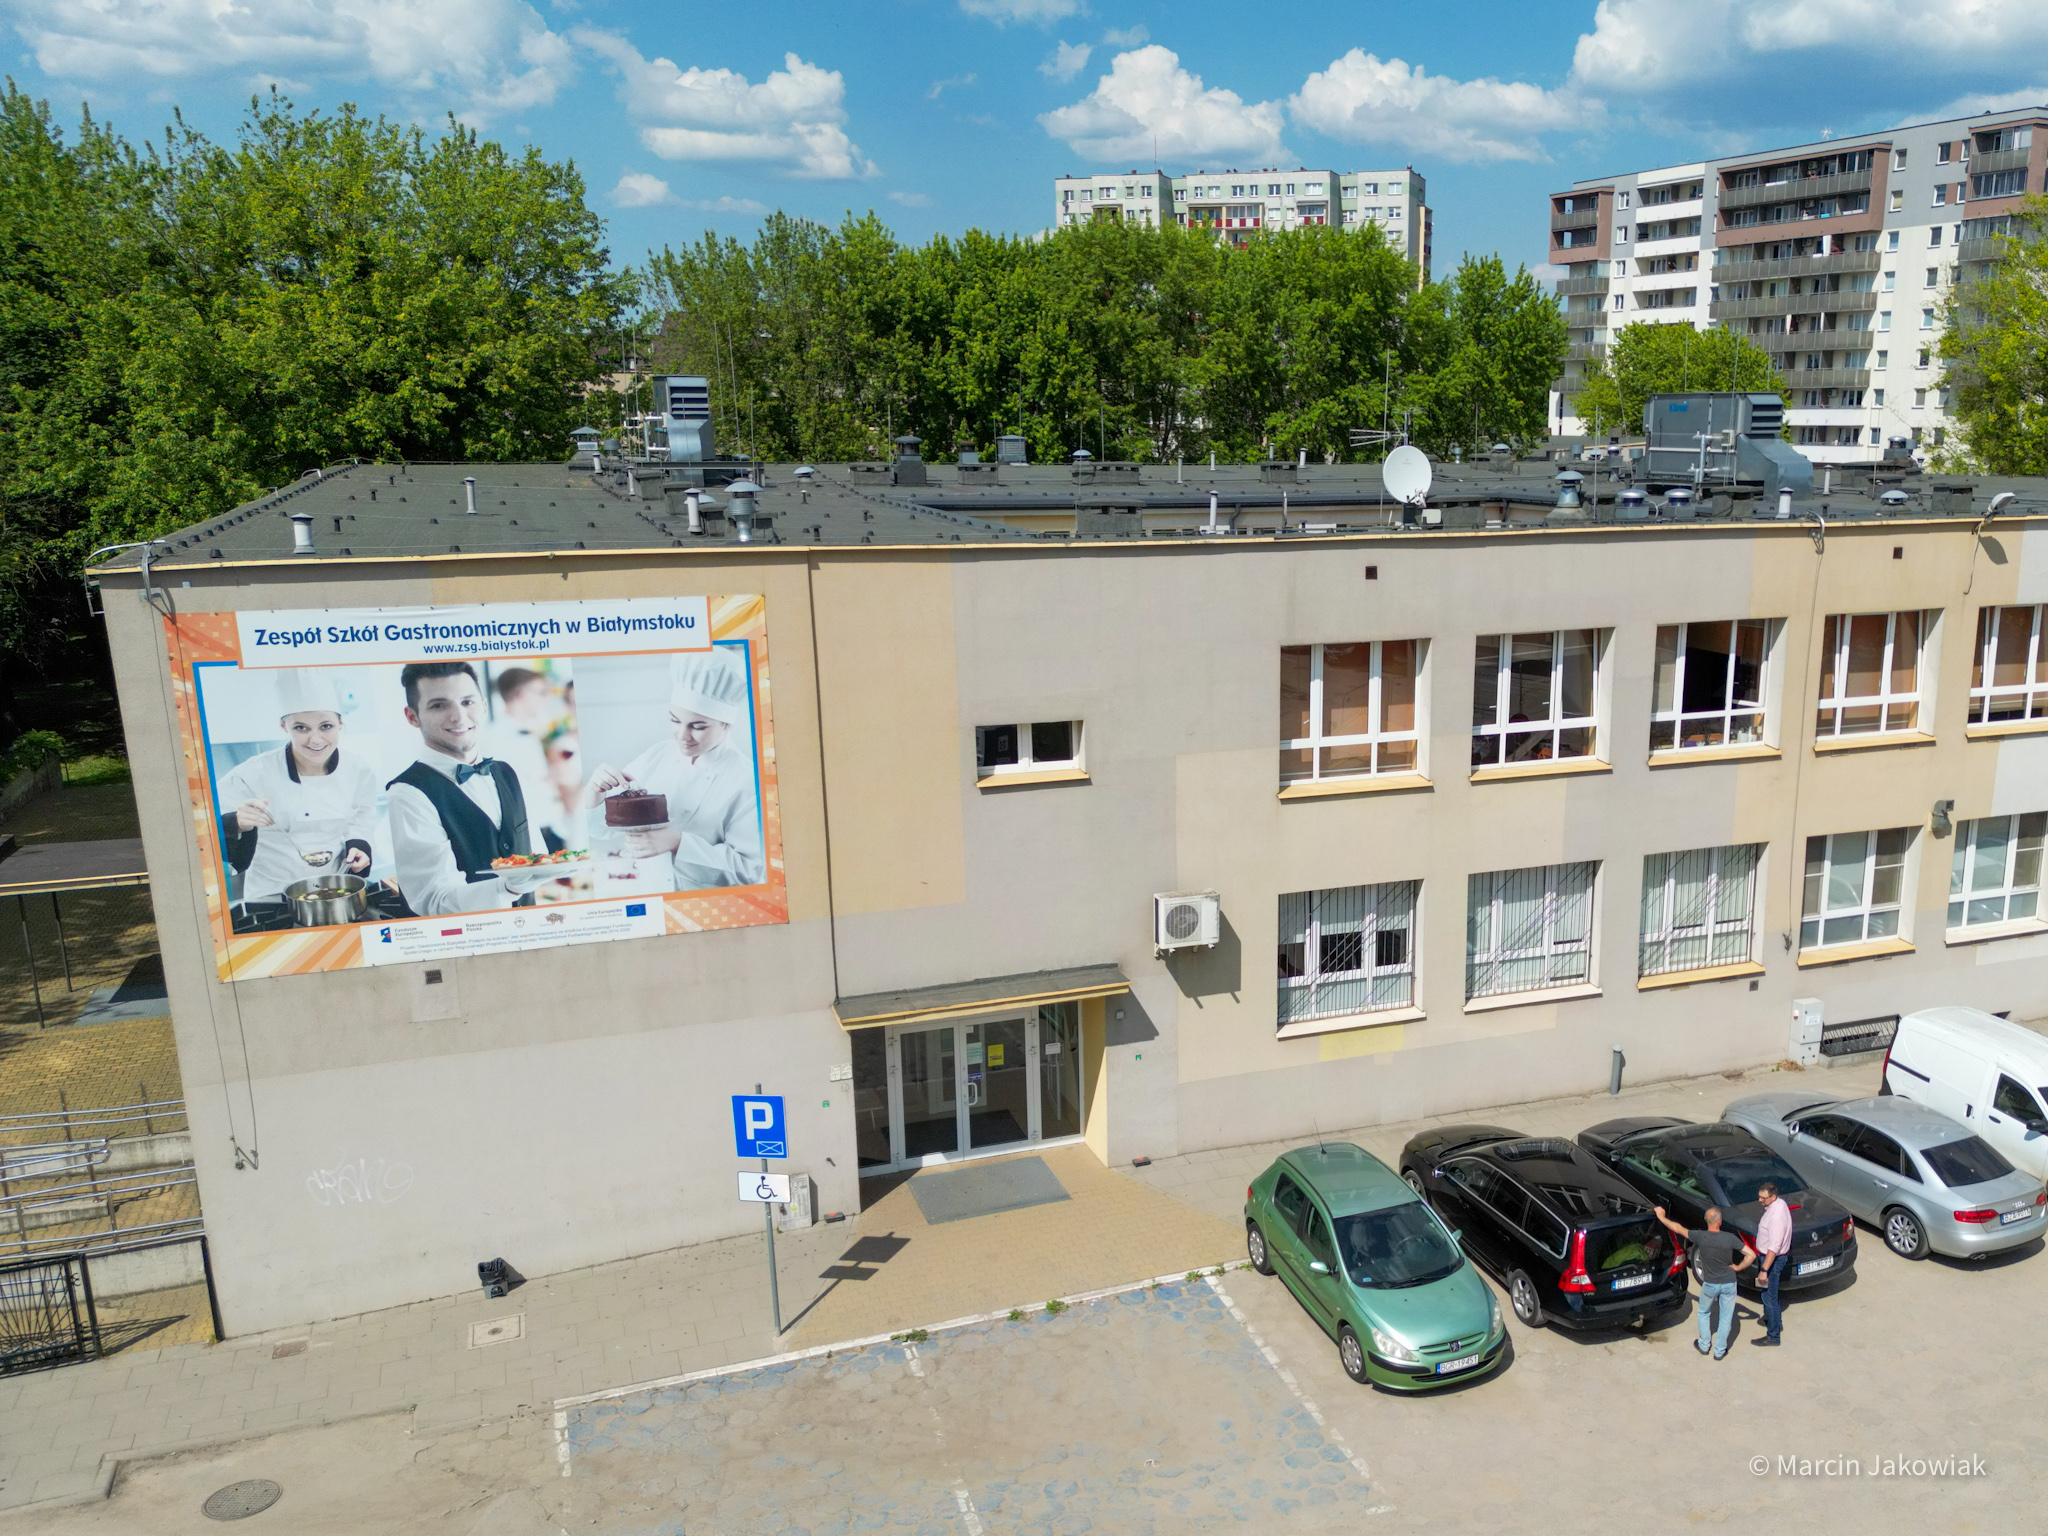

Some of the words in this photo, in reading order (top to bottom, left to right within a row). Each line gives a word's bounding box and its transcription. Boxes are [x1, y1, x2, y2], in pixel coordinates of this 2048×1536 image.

[255, 627, 322, 647] Zespół
[327, 625, 379, 643] Szkół
[384, 618, 561, 641] Gastronomicznych
[565, 620, 581, 633] w
[587, 614, 695, 634] Białymstoku
[423, 638, 550, 654] www.zsg.bialystok.pl
[744, 1101, 774, 1140] P
